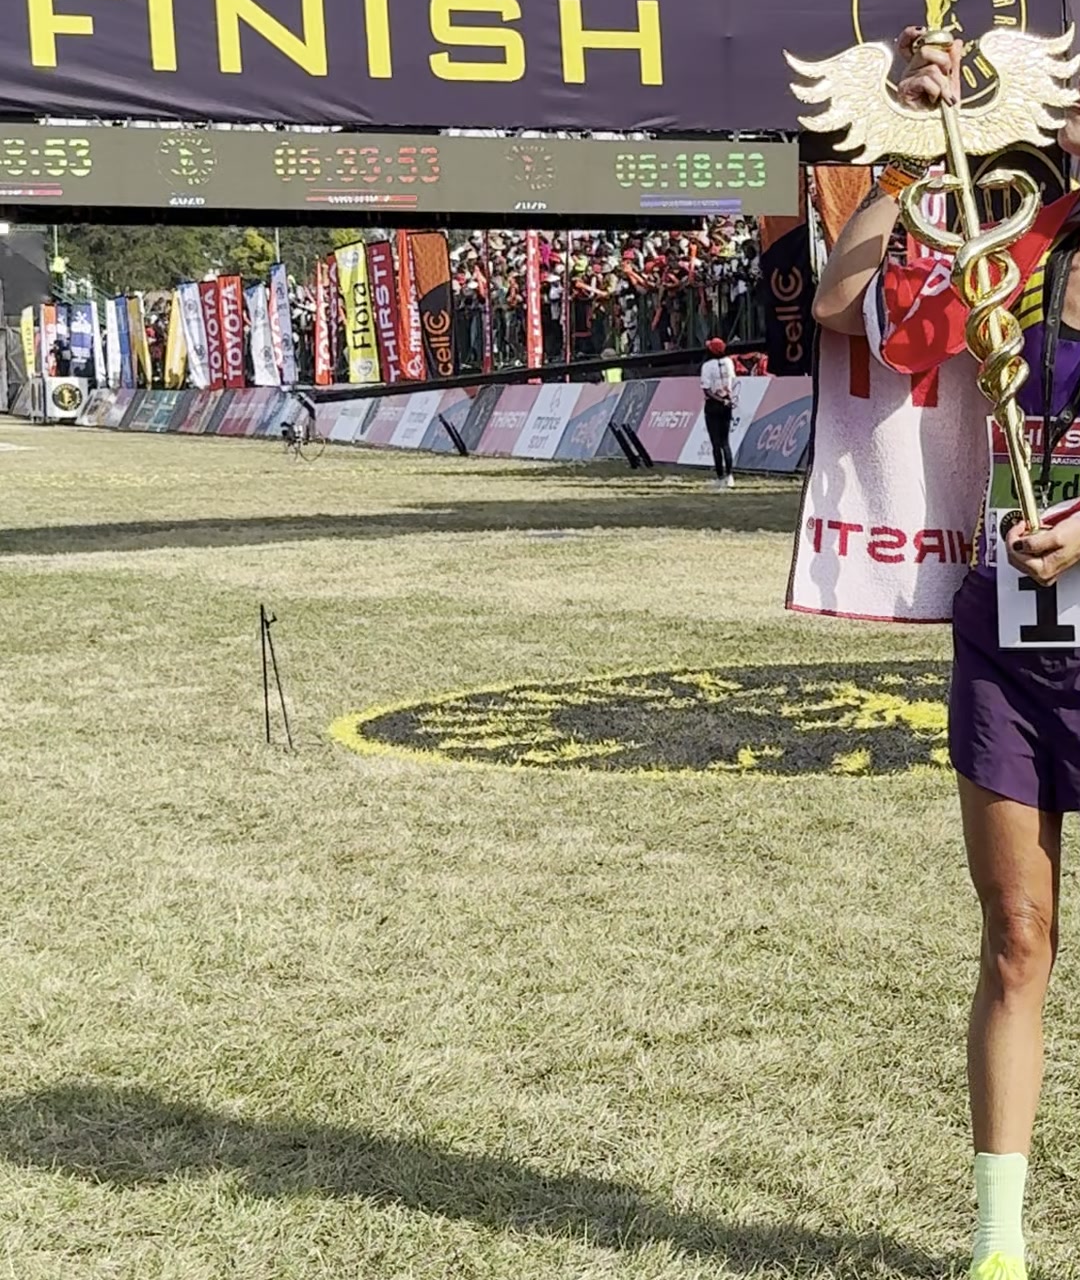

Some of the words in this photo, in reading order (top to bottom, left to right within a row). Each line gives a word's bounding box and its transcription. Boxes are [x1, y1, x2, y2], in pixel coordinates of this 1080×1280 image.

[204, 288, 223, 383] TOYOTA
[222, 282, 242, 381] TOYOTA
[352, 282, 372, 350] Flora
[1018, 576, 1075, 642] 1
